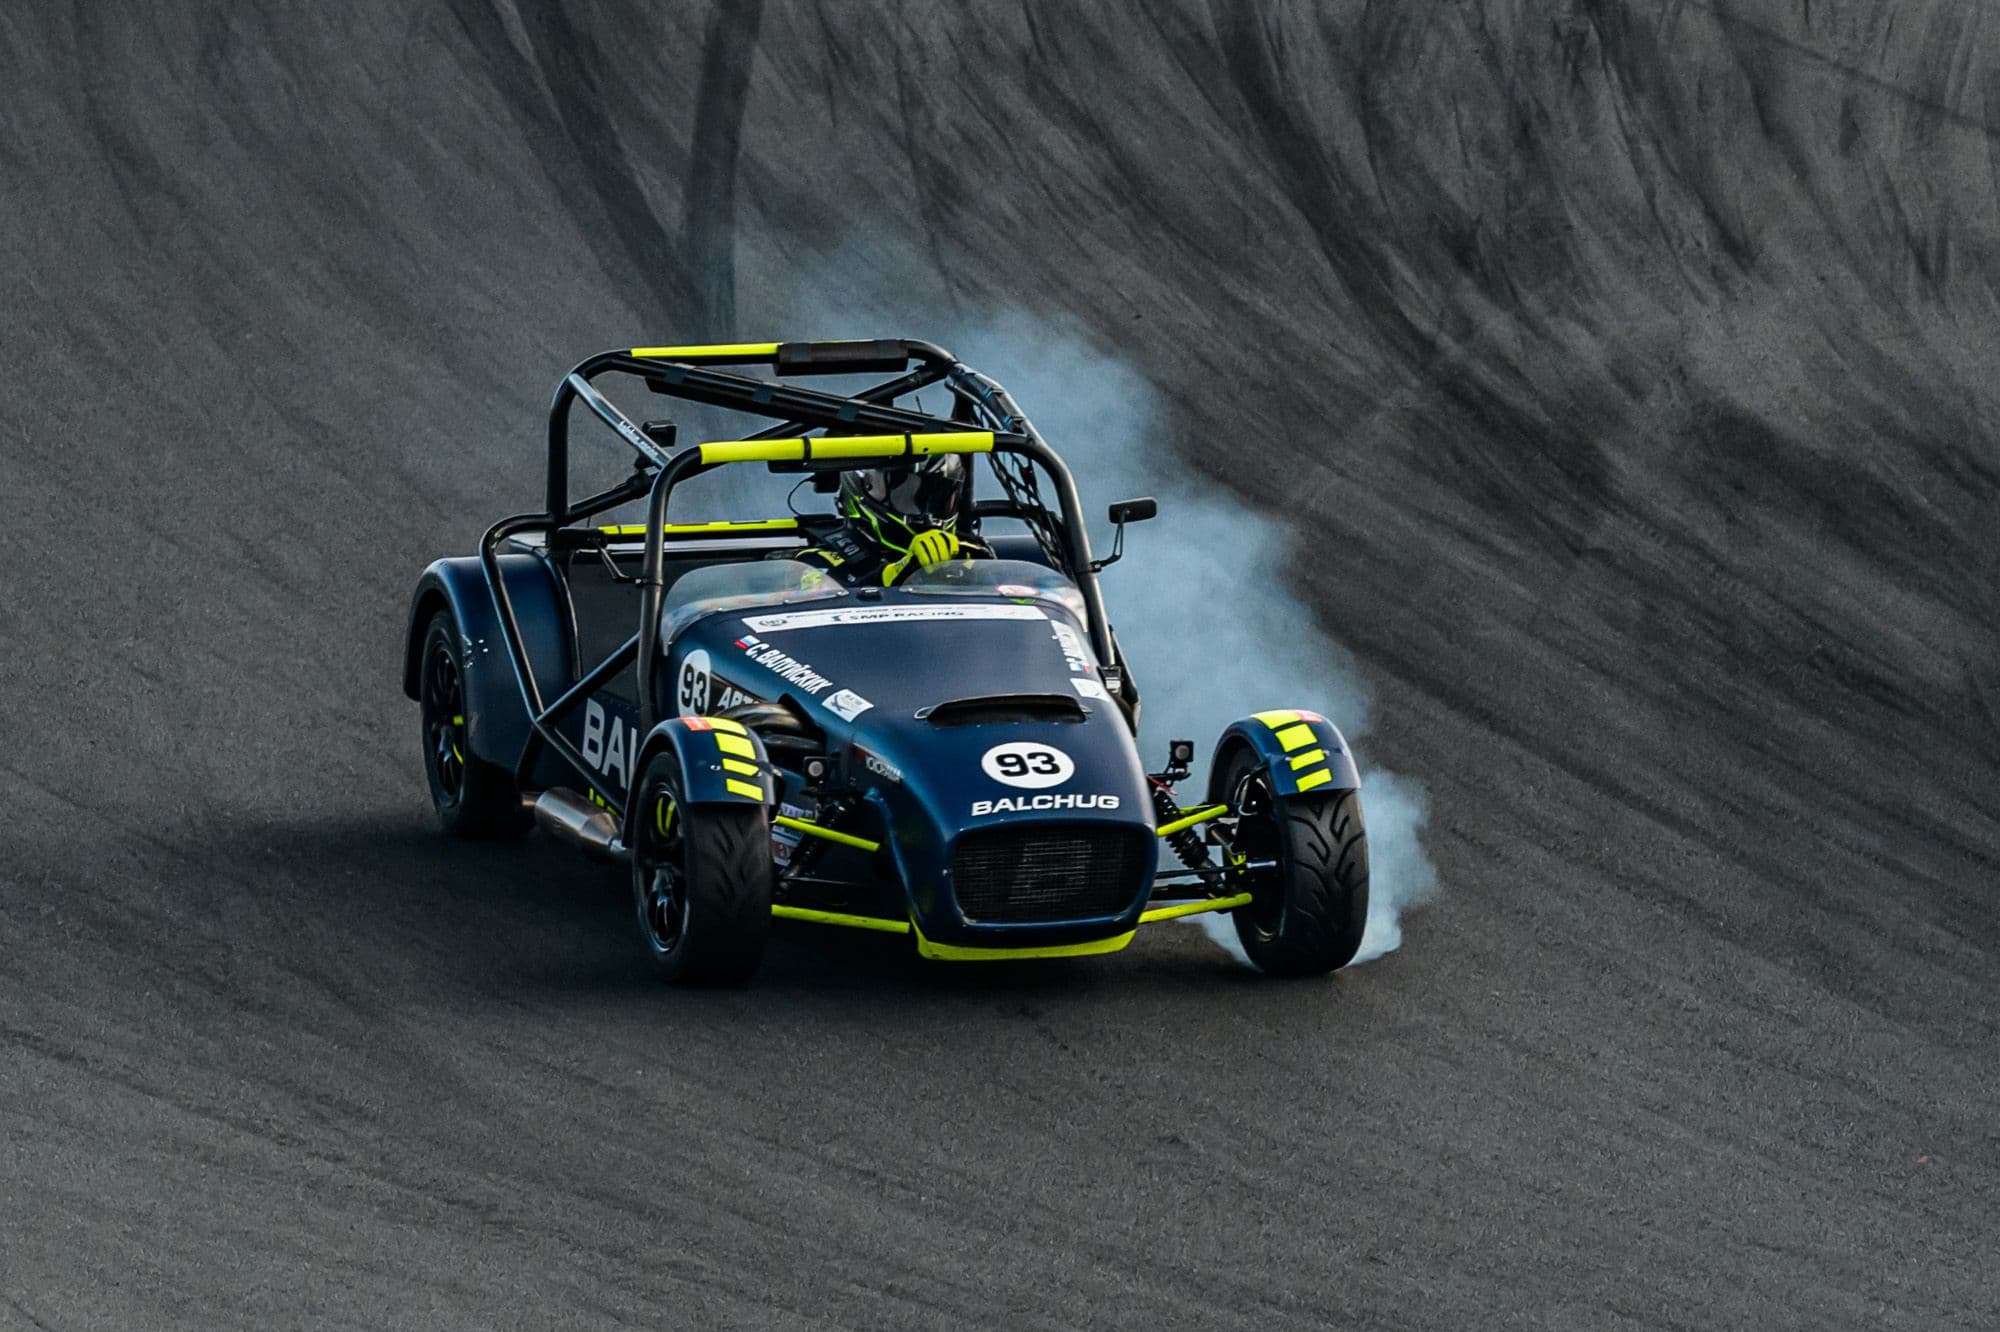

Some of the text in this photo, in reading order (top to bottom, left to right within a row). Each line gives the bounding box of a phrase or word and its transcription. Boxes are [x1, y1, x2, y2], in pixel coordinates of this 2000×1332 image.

[849, 612, 889, 620] SMP
[681, 663, 707, 716] 93
[995, 752, 1060, 777] 93
[971, 794, 1120, 816] BALCHUG
